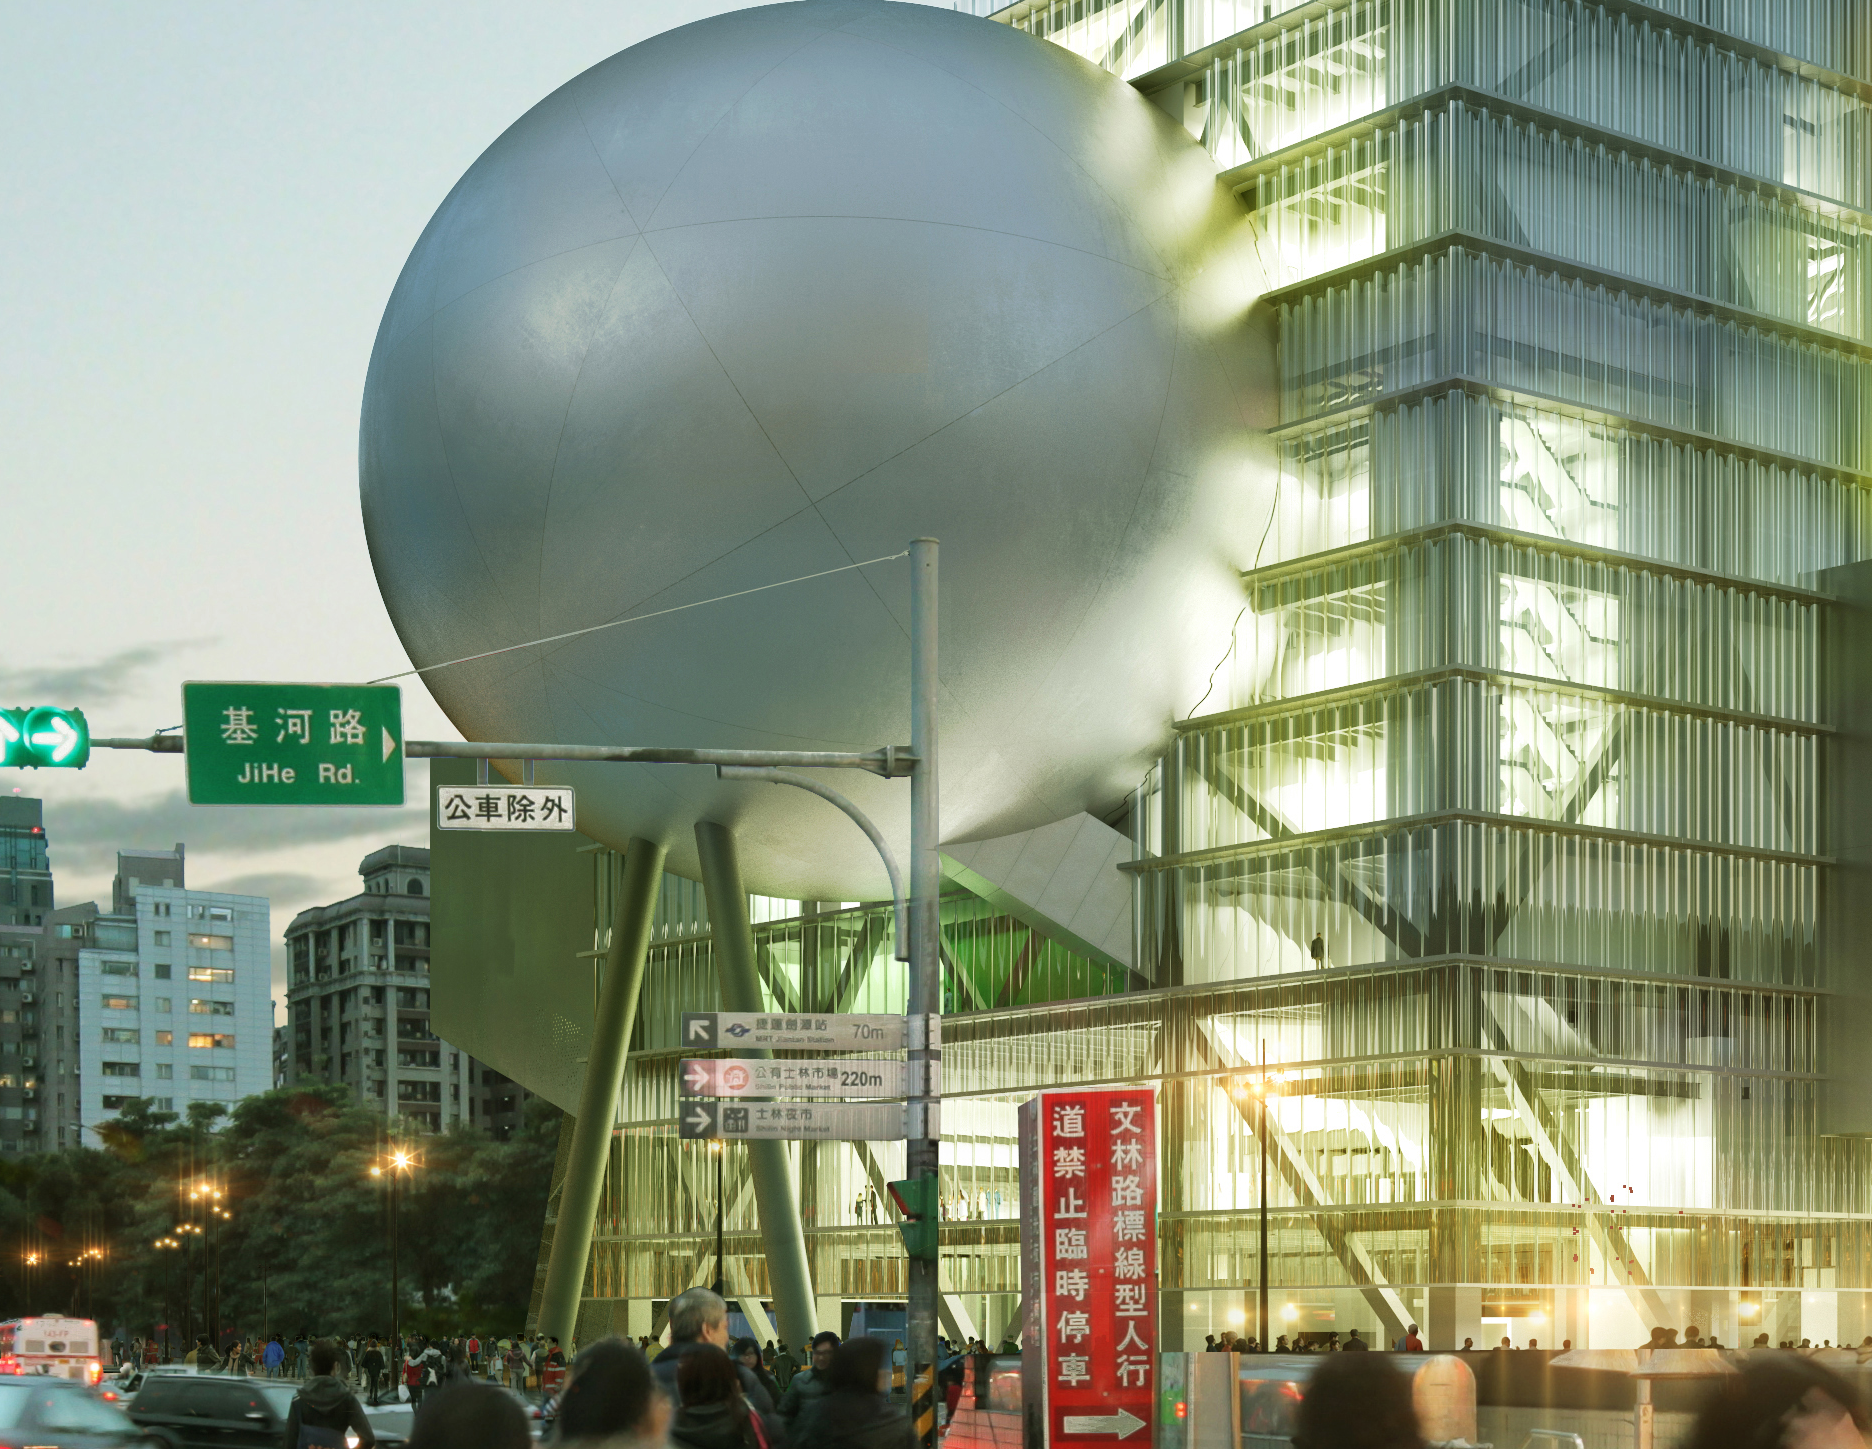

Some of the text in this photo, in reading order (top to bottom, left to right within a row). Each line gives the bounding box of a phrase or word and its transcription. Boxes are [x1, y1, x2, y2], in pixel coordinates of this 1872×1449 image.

[220, 706, 367, 745] 基河路
[238, 762, 361, 783] JiHe Rd.
[444, 793, 568, 823] 公車除外
[852, 1024, 884, 1040] 70m
[755, 1066, 883, 1087] 公有士林市場 220m
[755, 1108, 813, 1121] 士林夜市
[1053, 1105, 1091, 1387] 道禁止臨時停車
[1110, 1101, 1150, 1387] 文林路標線型人行
